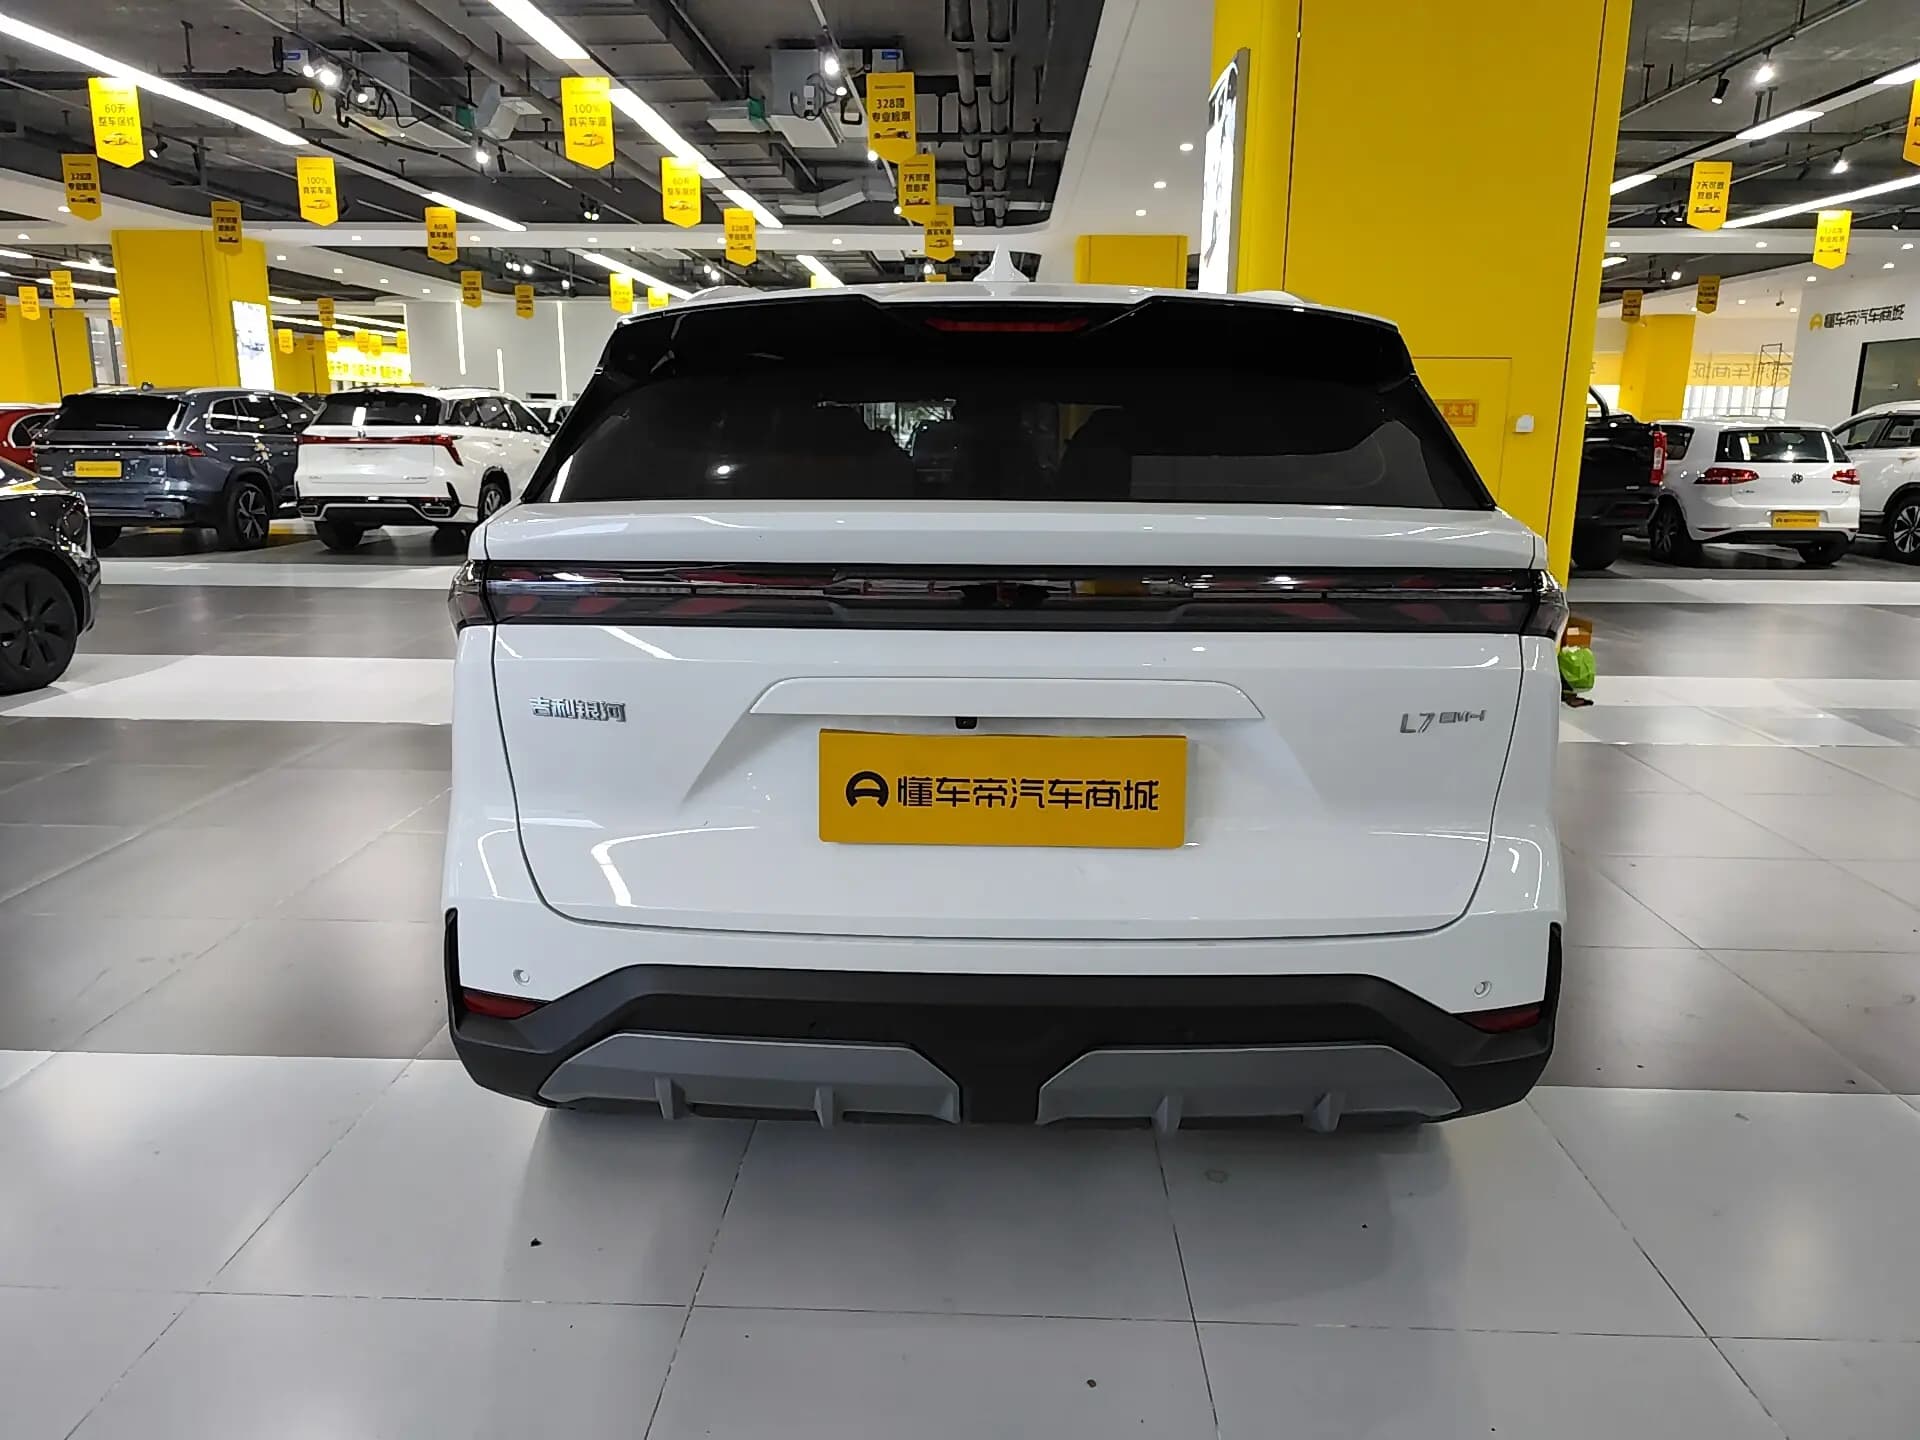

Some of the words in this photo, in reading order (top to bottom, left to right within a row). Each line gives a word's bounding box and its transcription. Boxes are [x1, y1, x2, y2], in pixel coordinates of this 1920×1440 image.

[528, 696, 627, 723] 吉利银河
[1400, 713, 1435, 733] L7
[896, 774, 1160, 811] 懂车帝汽车商城
